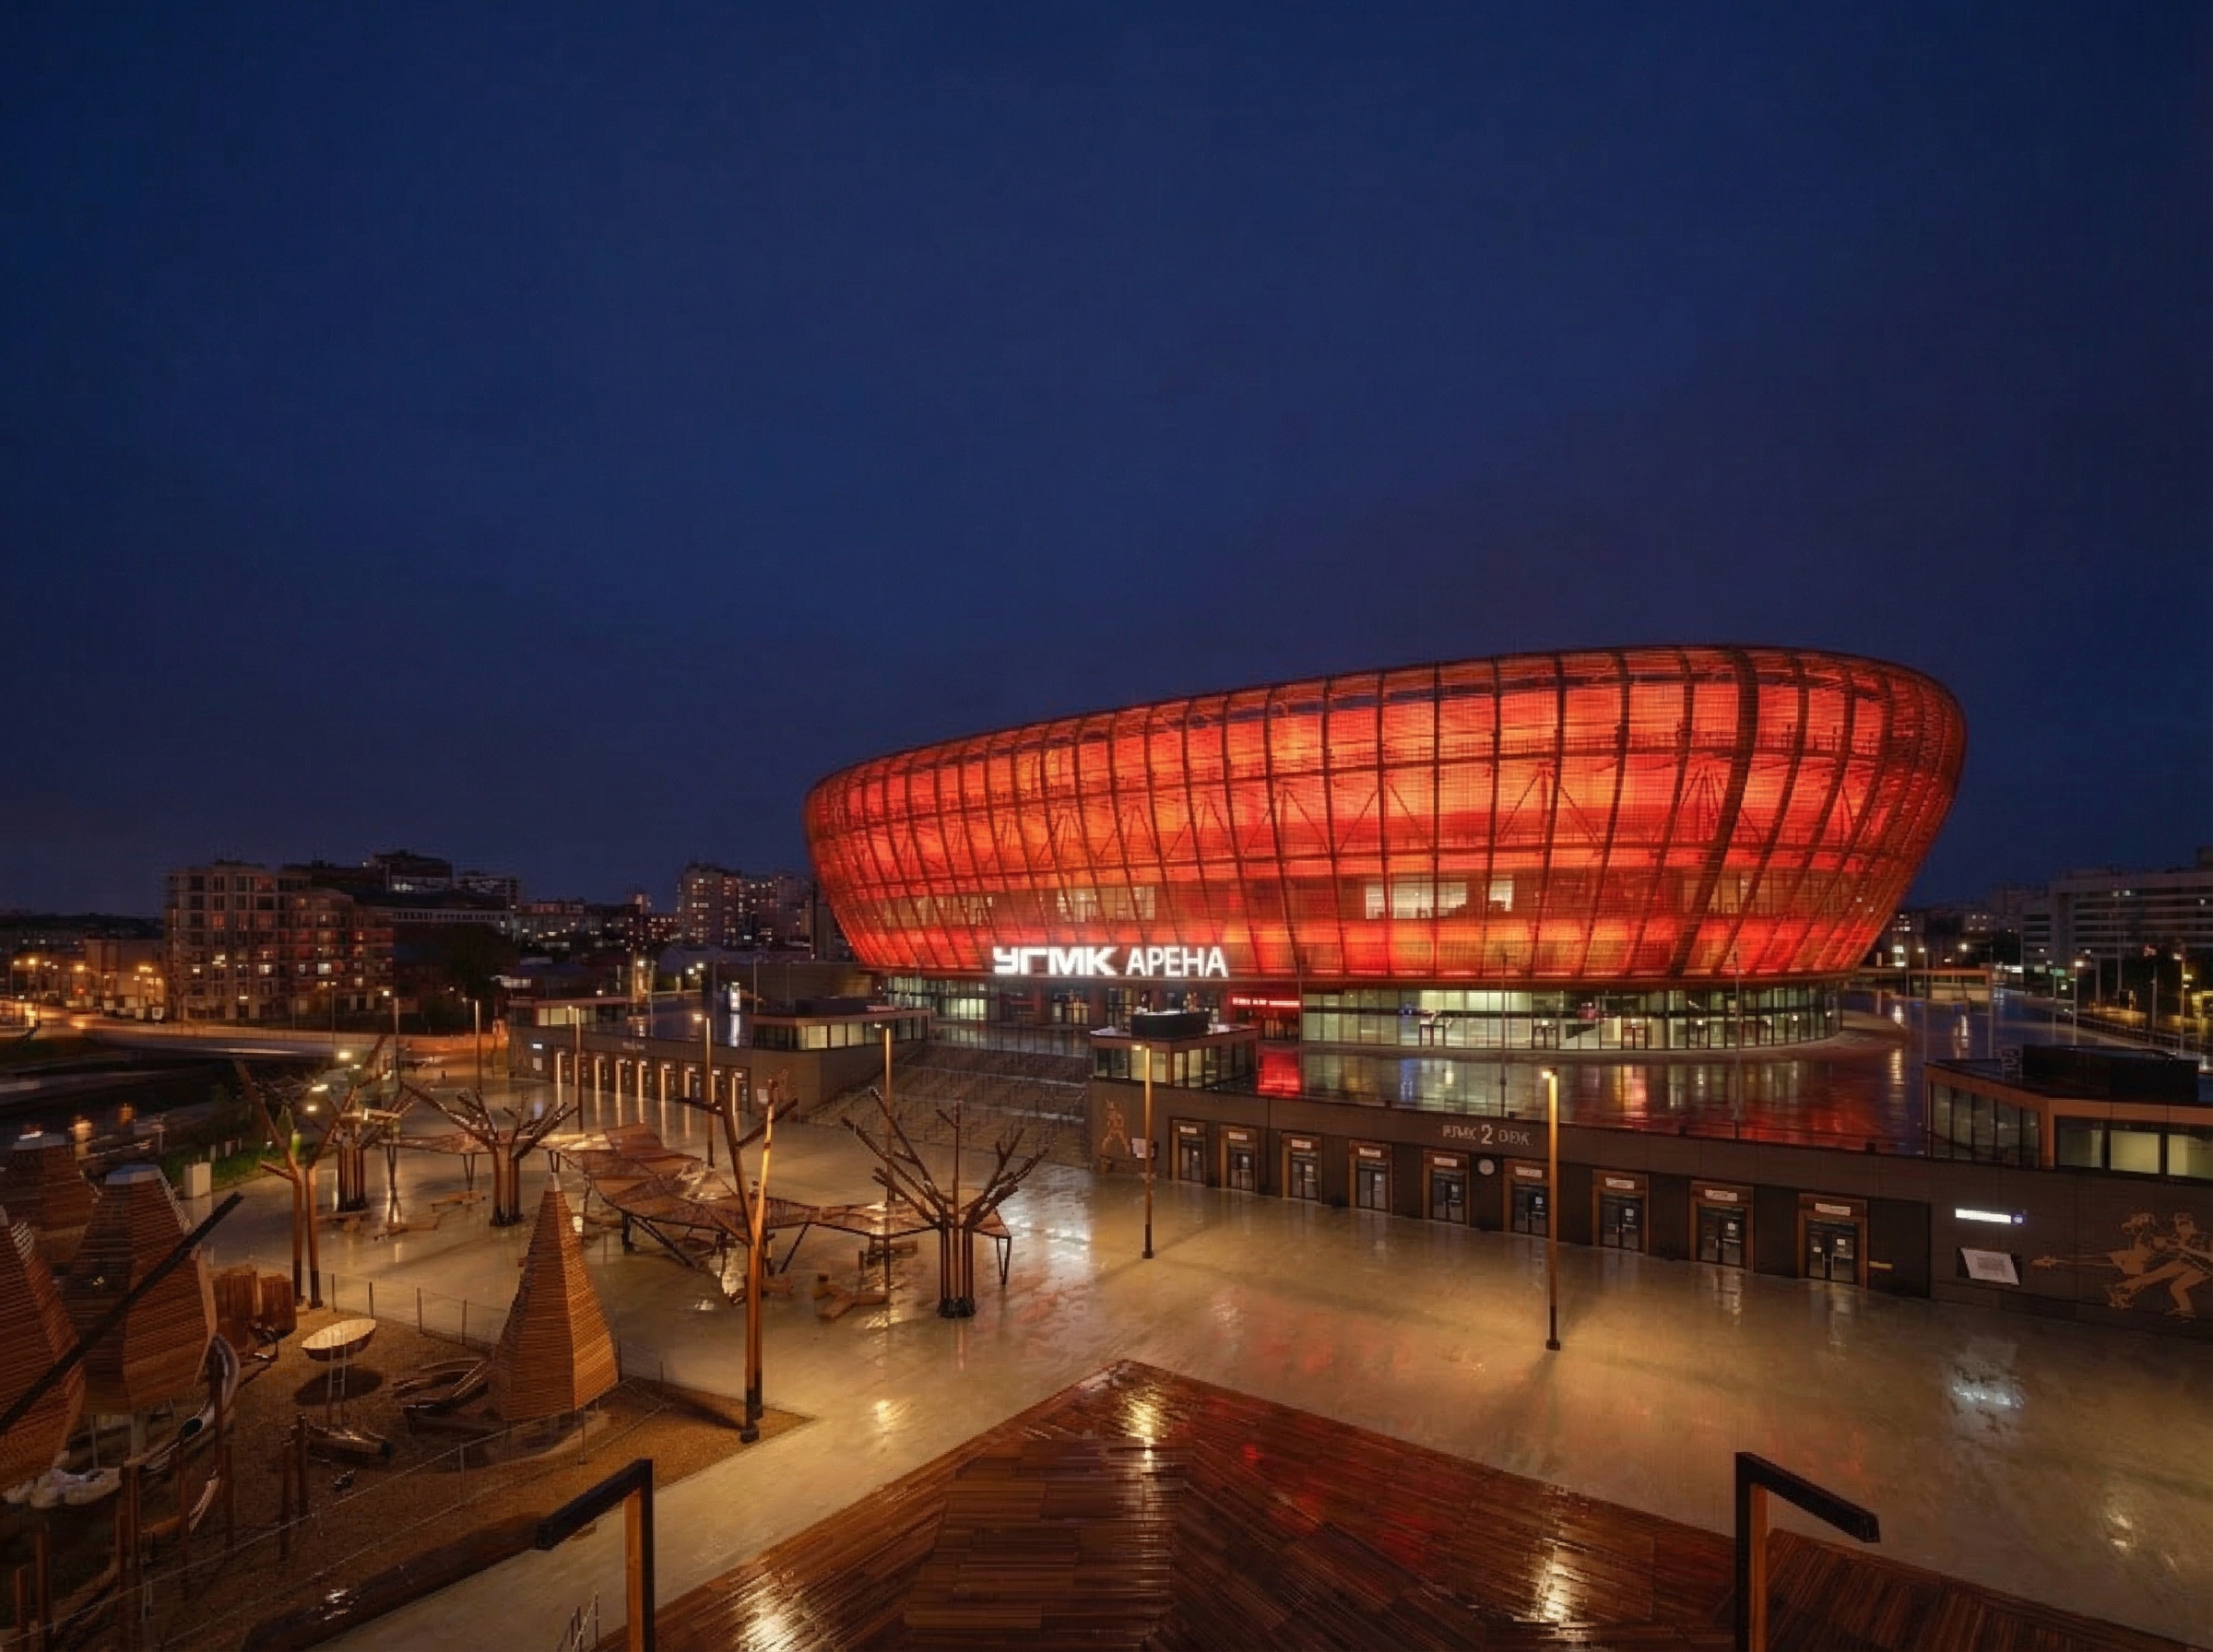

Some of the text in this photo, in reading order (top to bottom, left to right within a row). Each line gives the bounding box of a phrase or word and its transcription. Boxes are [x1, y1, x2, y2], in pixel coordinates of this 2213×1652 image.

[992, 946, 1229, 978] УГМК АРЕНА
[1481, 1124, 1493, 1145] 2
